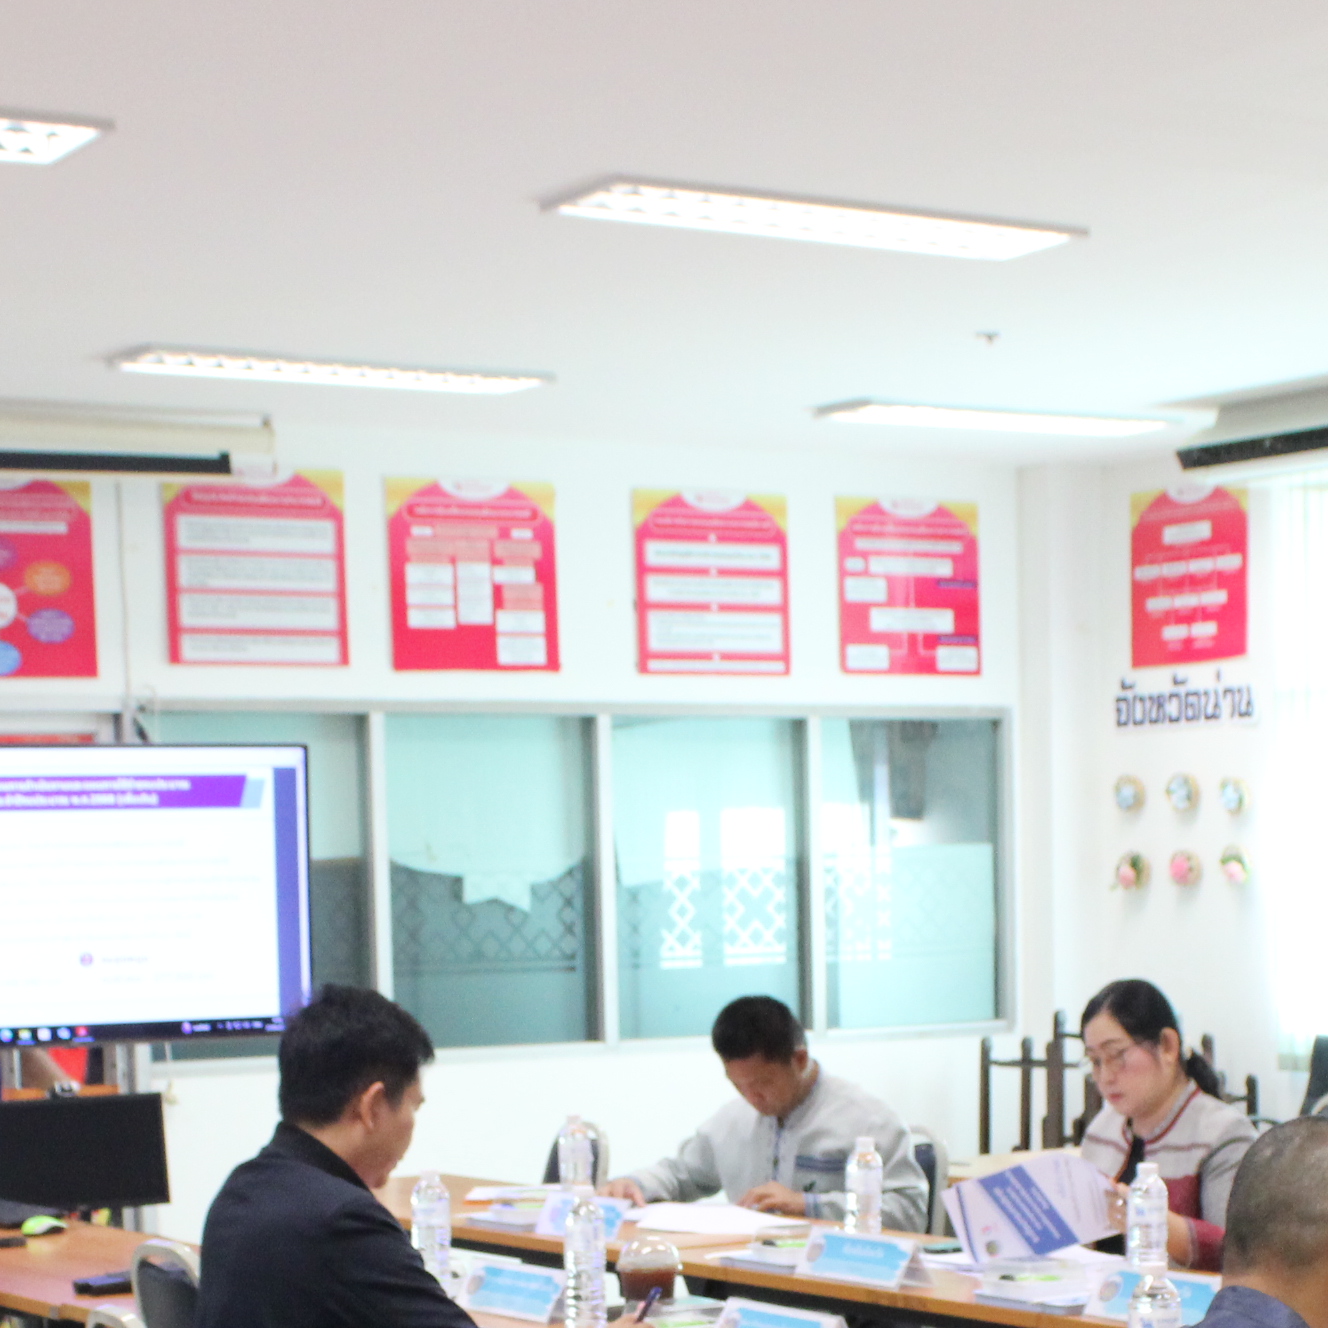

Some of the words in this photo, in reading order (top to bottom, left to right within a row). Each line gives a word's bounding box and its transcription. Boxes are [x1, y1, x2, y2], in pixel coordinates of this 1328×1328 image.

[1115, 668, 1254, 727] จังหวัดน่าน
